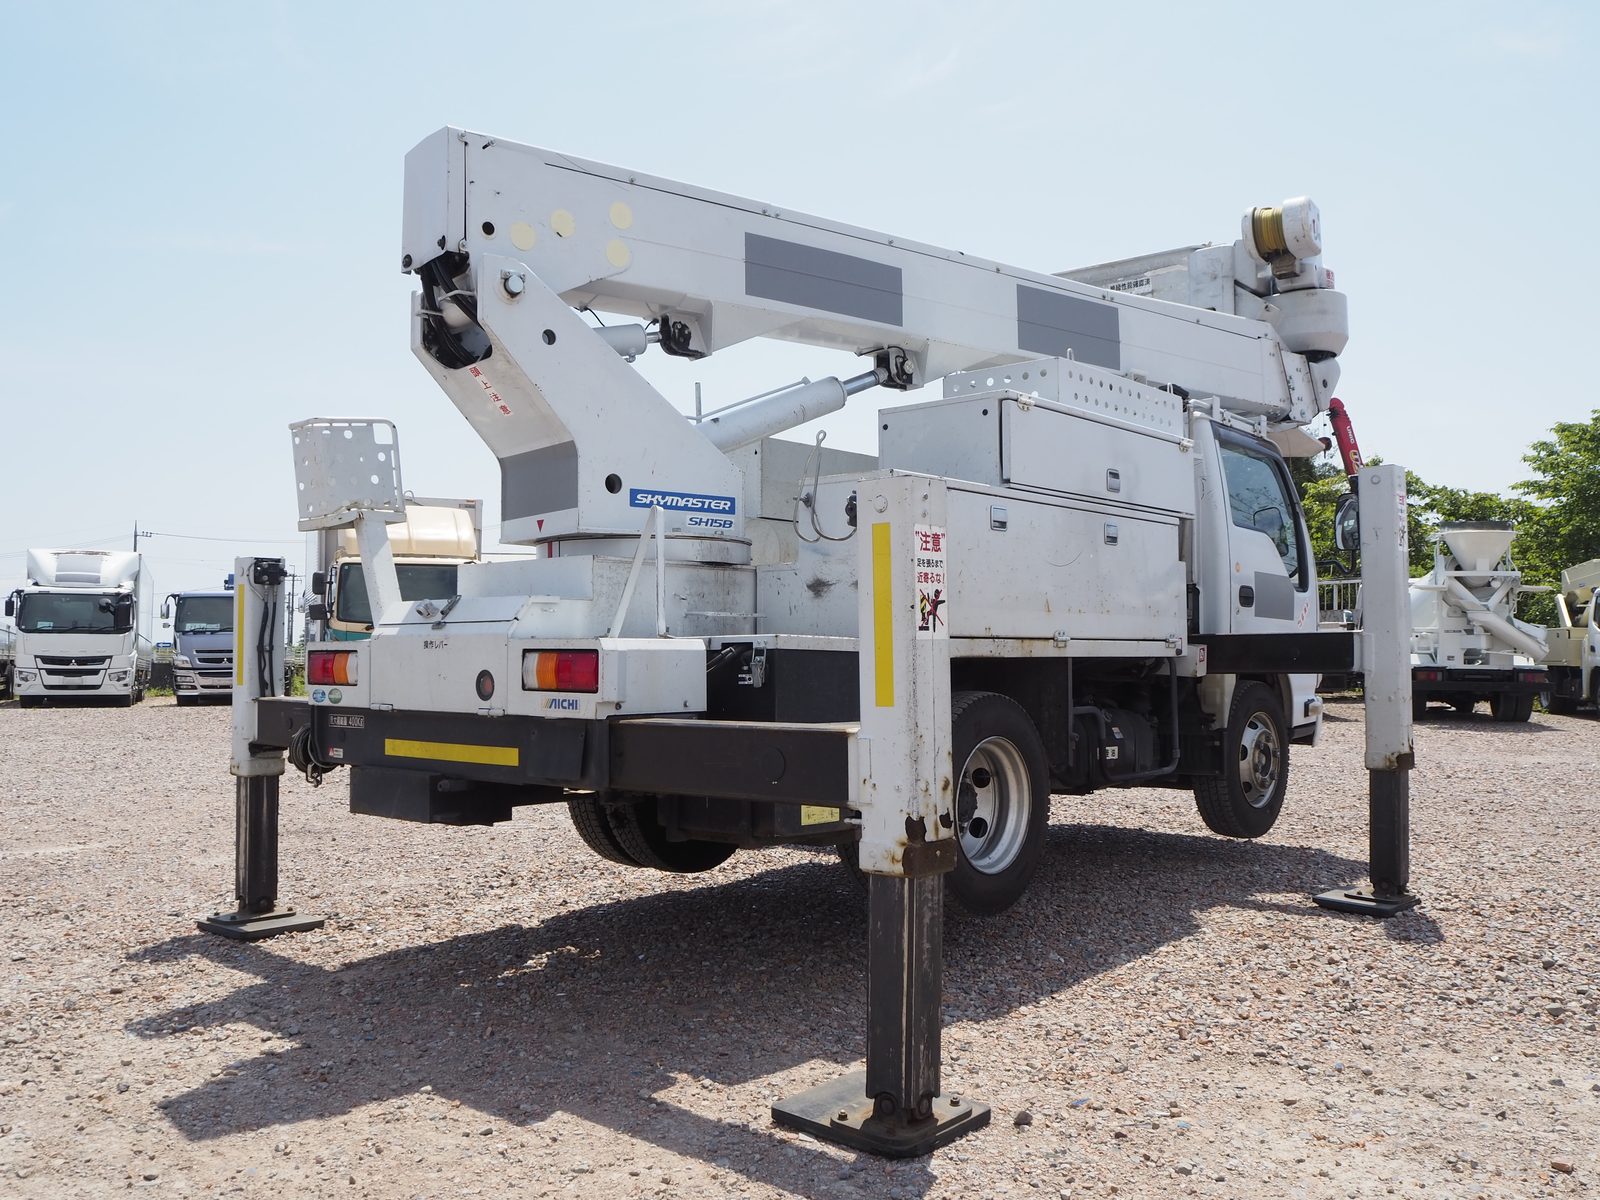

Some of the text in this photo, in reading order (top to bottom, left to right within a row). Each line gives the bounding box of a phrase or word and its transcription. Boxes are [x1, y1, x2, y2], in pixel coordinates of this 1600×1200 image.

[469, 366, 511, 415] 頭上注意
[635, 493, 731, 511] SKYMASTER
[687, 516, 734, 529] SH15B
[916, 557, 943, 569] 足を張るまで
[548, 698, 578, 710] AICHI
